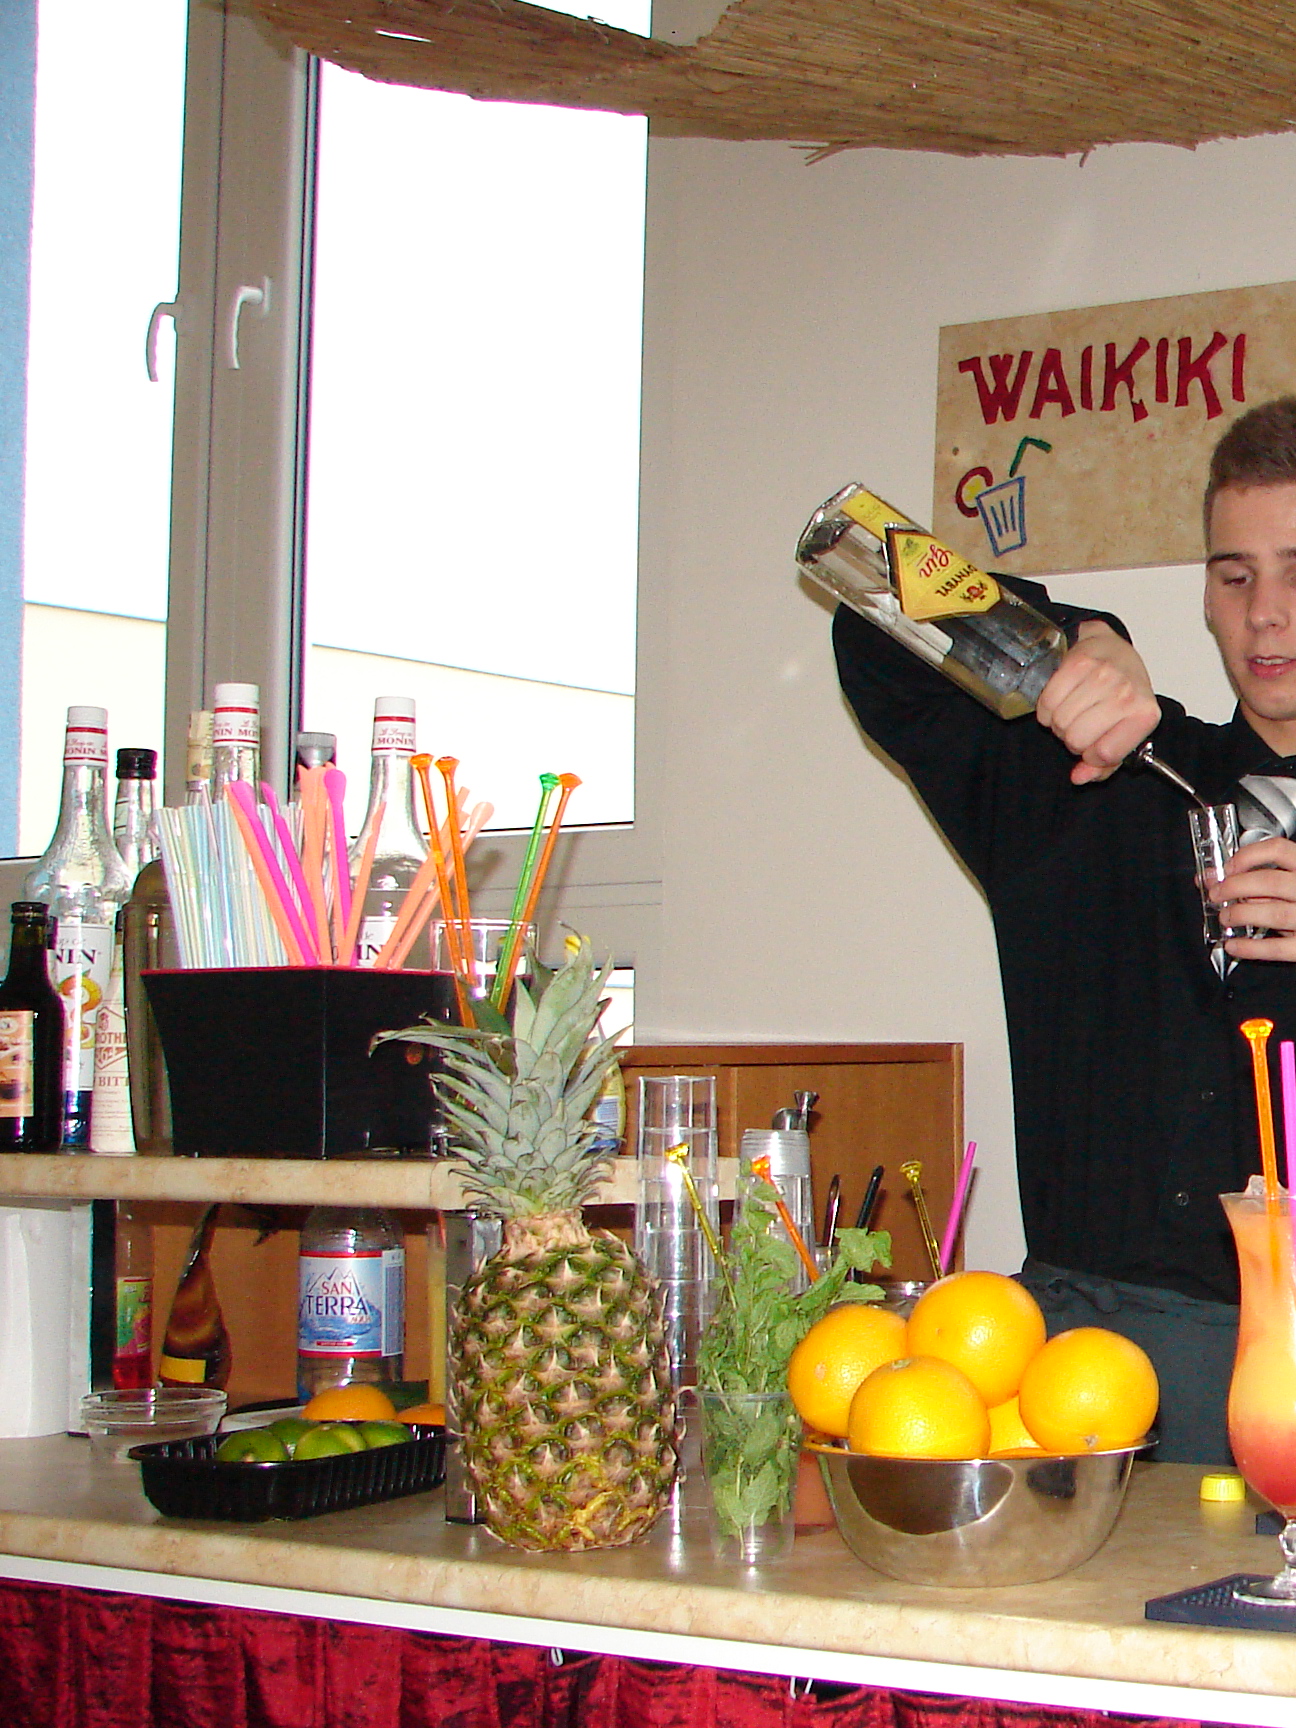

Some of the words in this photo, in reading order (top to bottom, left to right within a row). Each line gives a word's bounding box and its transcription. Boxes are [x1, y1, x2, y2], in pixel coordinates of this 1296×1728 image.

[958, 332, 1246, 425] WAIKIKI
[919, 543, 954, 579] Gin
[377, 737, 414, 746] MONIN
[66, 747, 97, 756] ONIN
[55, 948, 97, 964] NIN
[99, 1077, 128, 1087] BITT
[321, 1280, 352, 1295] SAN
[305, 1295, 368, 1316] TERRA
